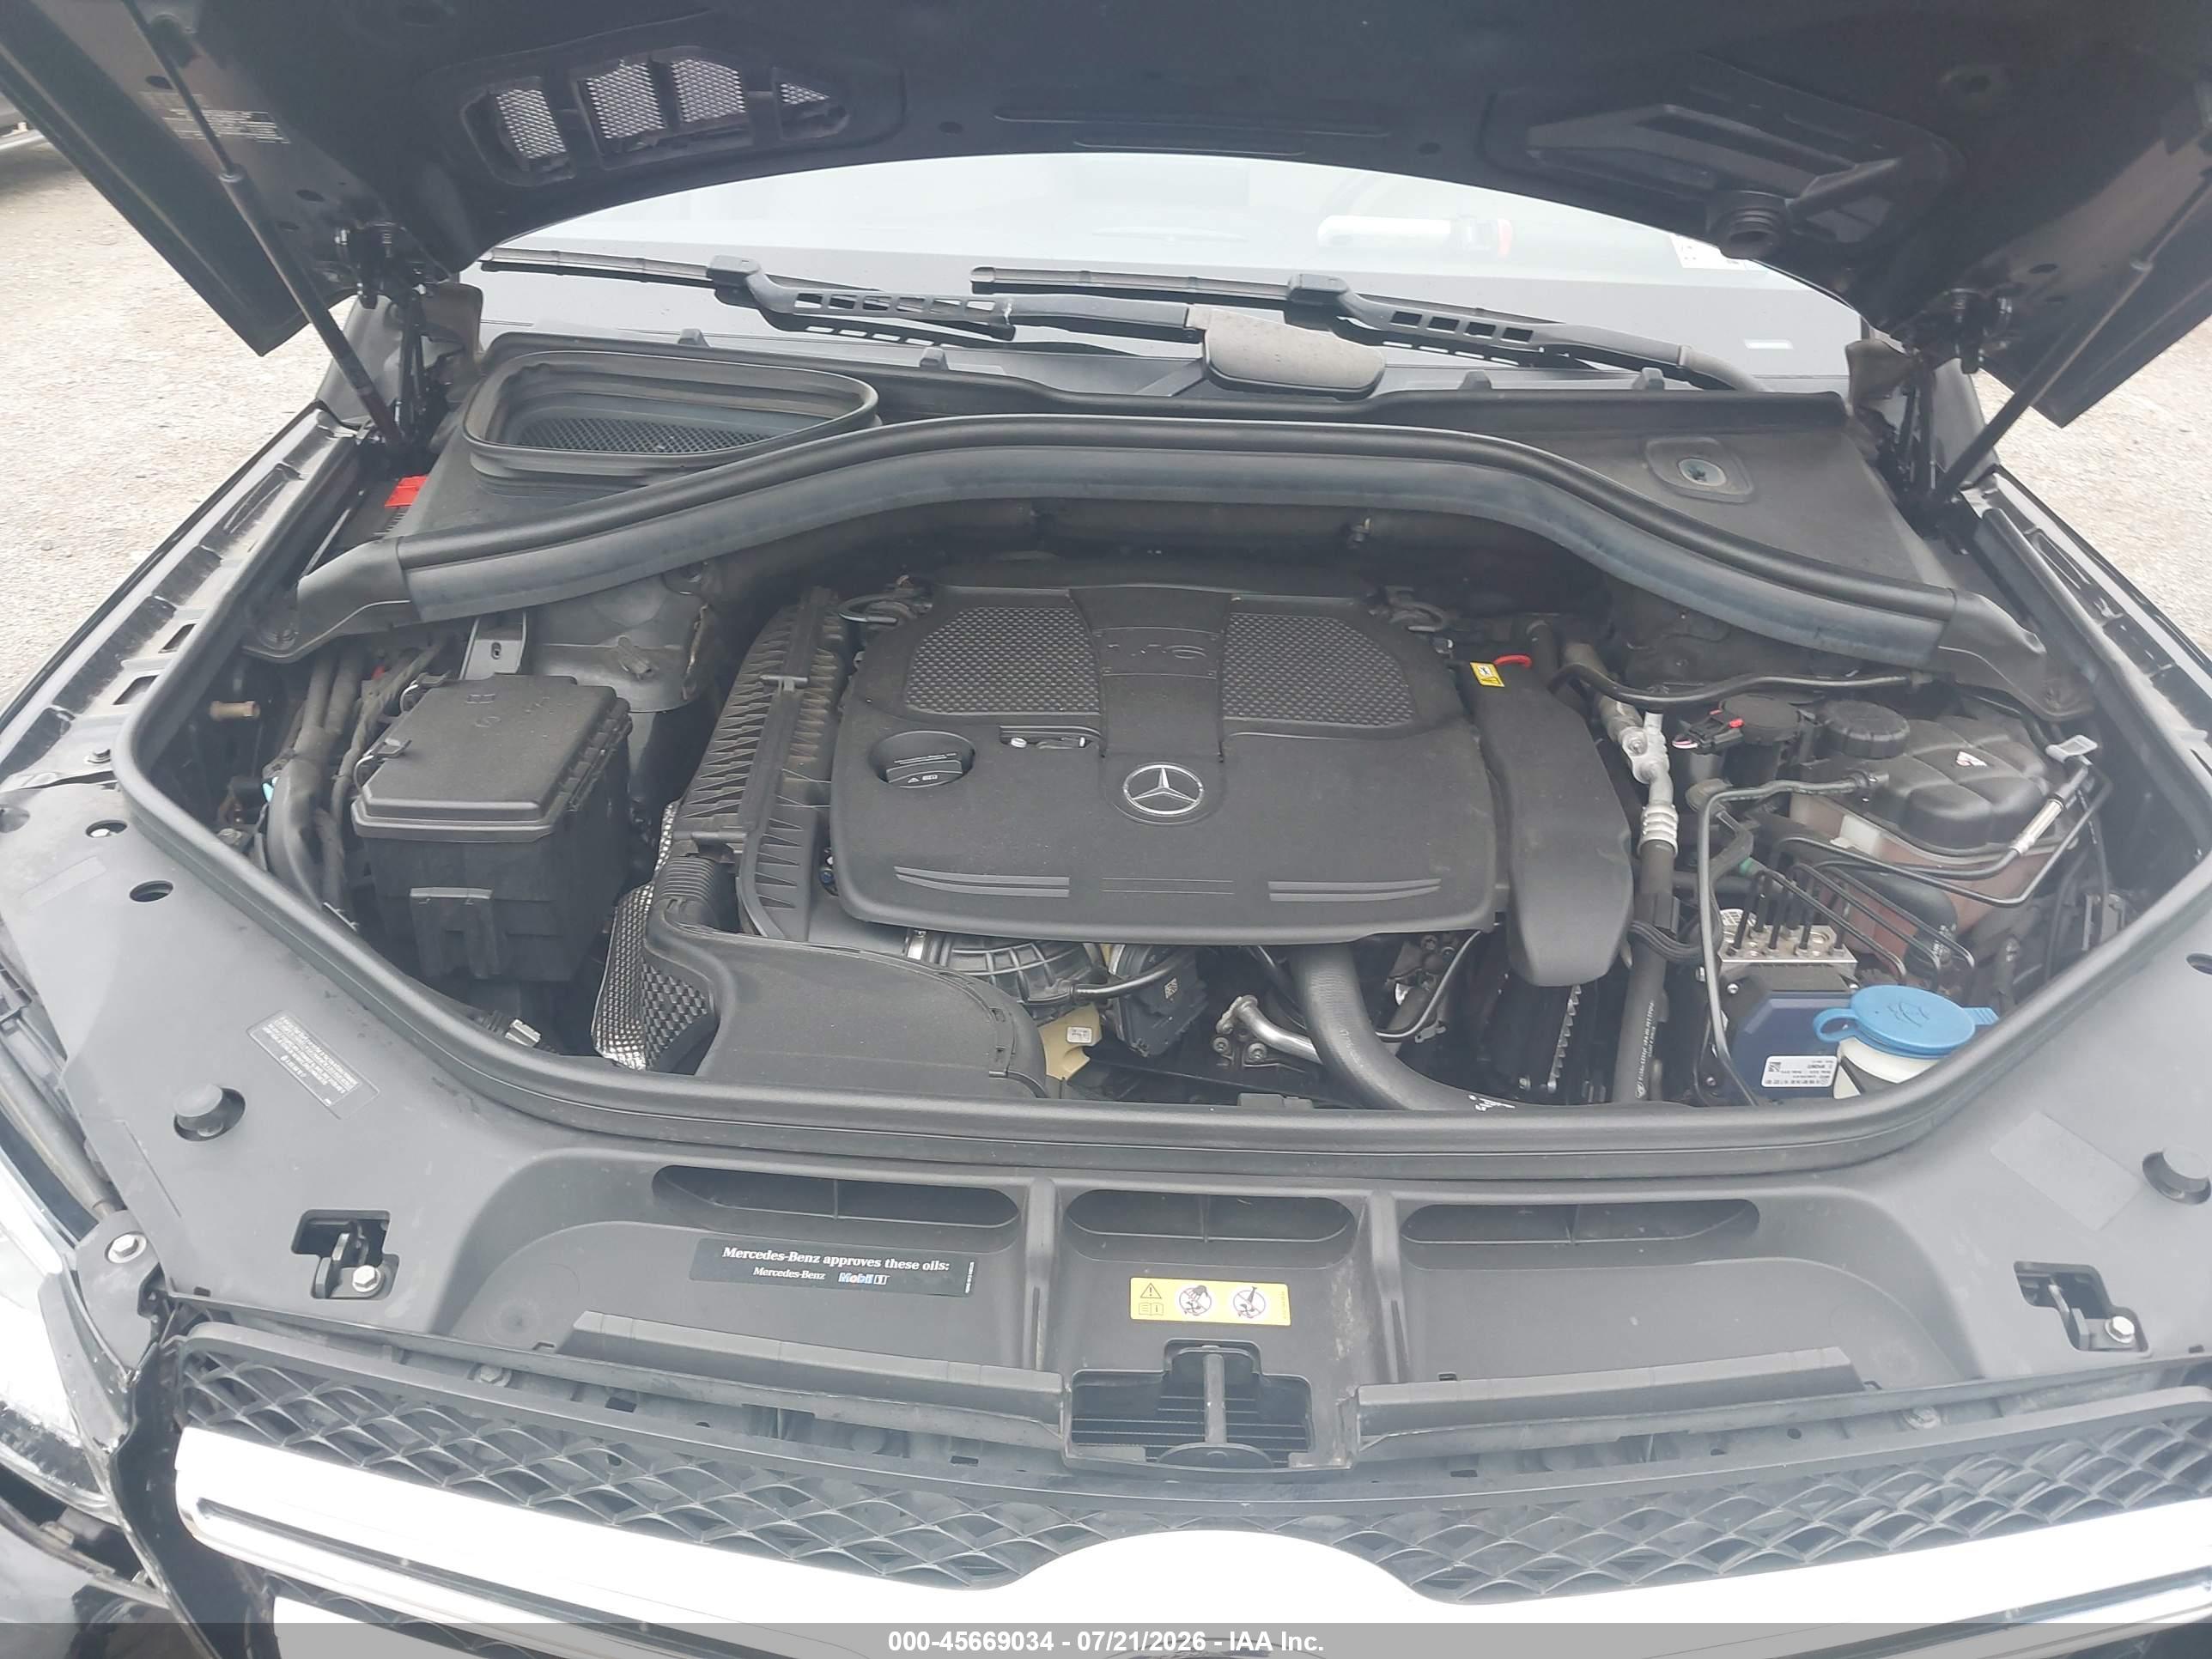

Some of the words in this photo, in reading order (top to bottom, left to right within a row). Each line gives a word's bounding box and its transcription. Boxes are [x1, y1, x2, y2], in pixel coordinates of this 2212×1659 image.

[722, 1247, 820, 1263] Mercedes-Benz
[823, 1255, 882, 1268] approves
[884, 1258, 920, 1270] these
[922, 1260, 950, 1271] oils:
[753, 1267, 826, 1279] Mercedes-Benz
[838, 1272, 873, 1285] Mobil
